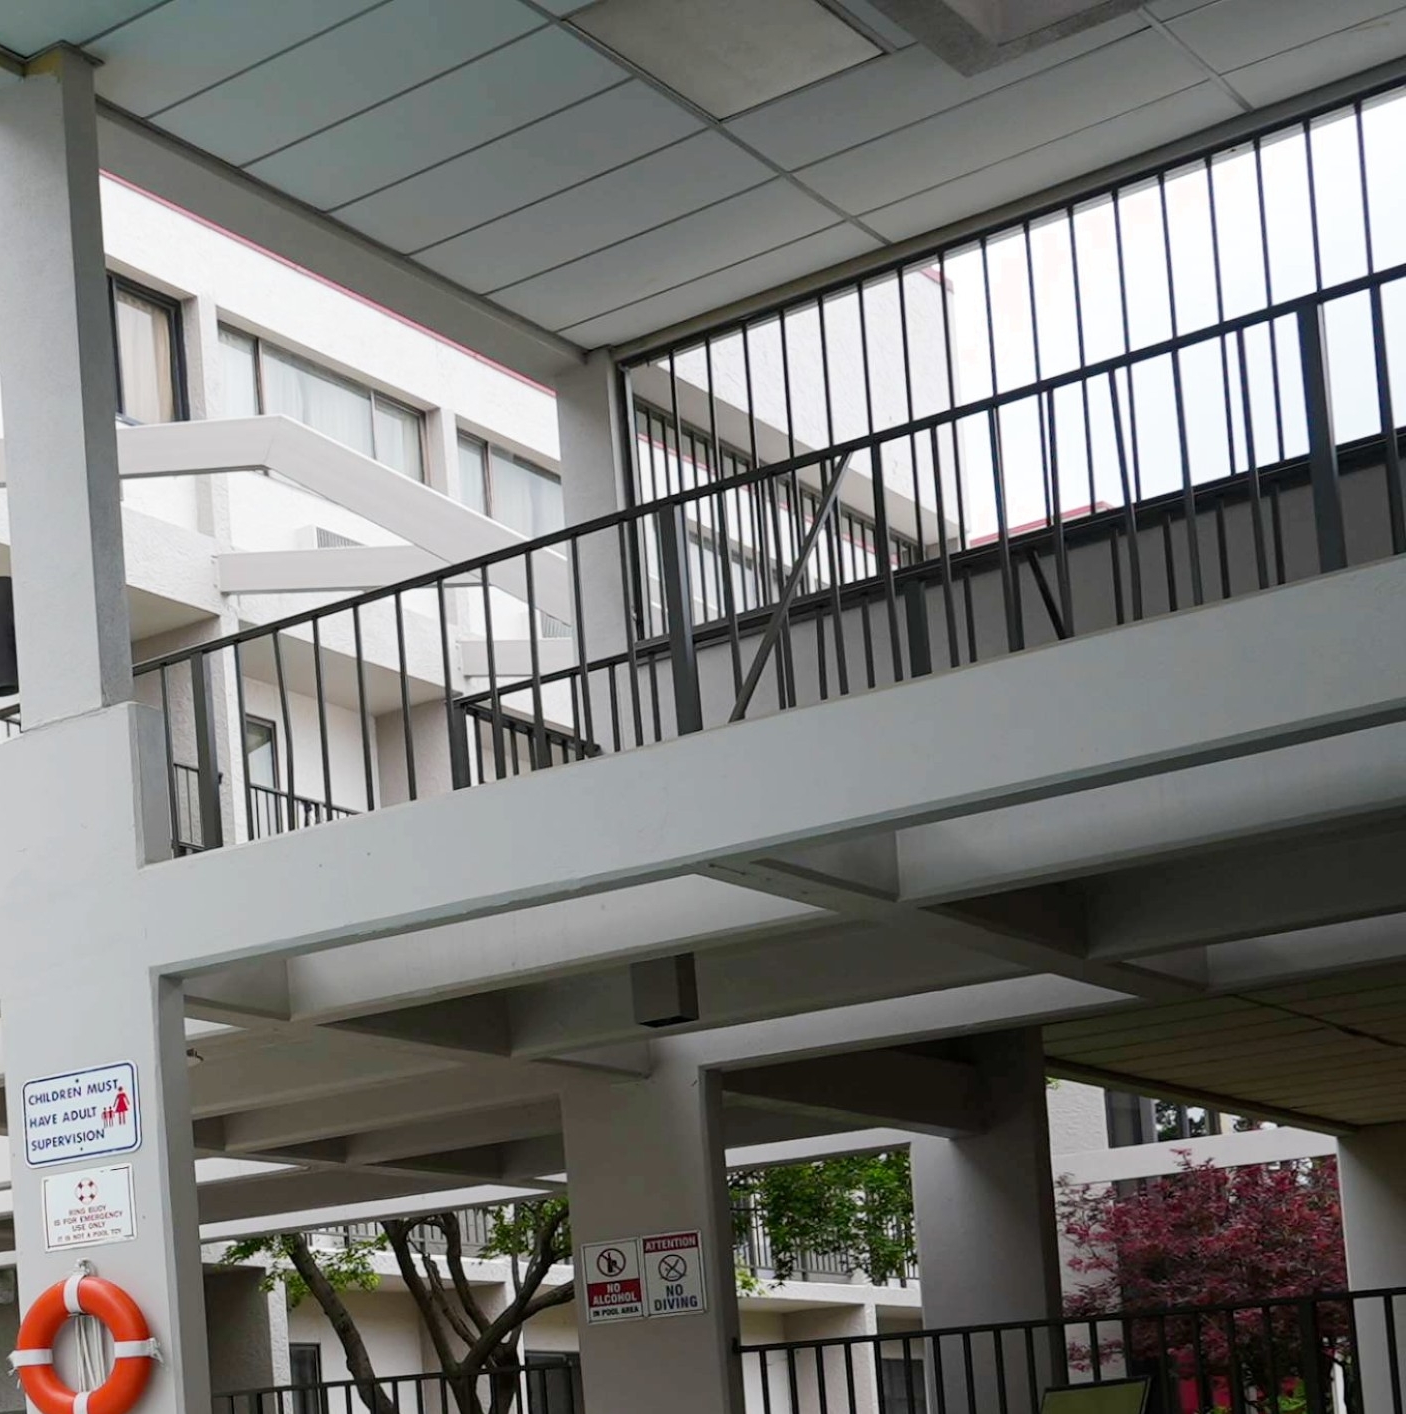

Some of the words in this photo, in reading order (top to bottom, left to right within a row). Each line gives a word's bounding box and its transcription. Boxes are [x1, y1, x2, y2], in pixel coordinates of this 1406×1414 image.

[28, 1087, 82, 1105] CHILDREN
[87, 1079, 119, 1095] MUST
[30, 1114, 57, 1128] HAVE
[62, 1107, 97, 1122] ADULT
[31, 1129, 105, 1151] SUPERVISION
[80, 1210, 123, 1223] EMERGENCY
[72, 1224, 86, 1232] USE
[88, 1221, 106, 1229] ONLY
[645, 1236, 695, 1252] ATTENTION
[607, 1283, 621, 1293] NO
[666, 1284, 683, 1297] NO
[592, 1292, 637, 1306] ALCOHOL
[654, 1295, 698, 1311] DIVING
[602, 1308, 619, 1316] POOL
[621, 1306, 639, 1314] AREA
